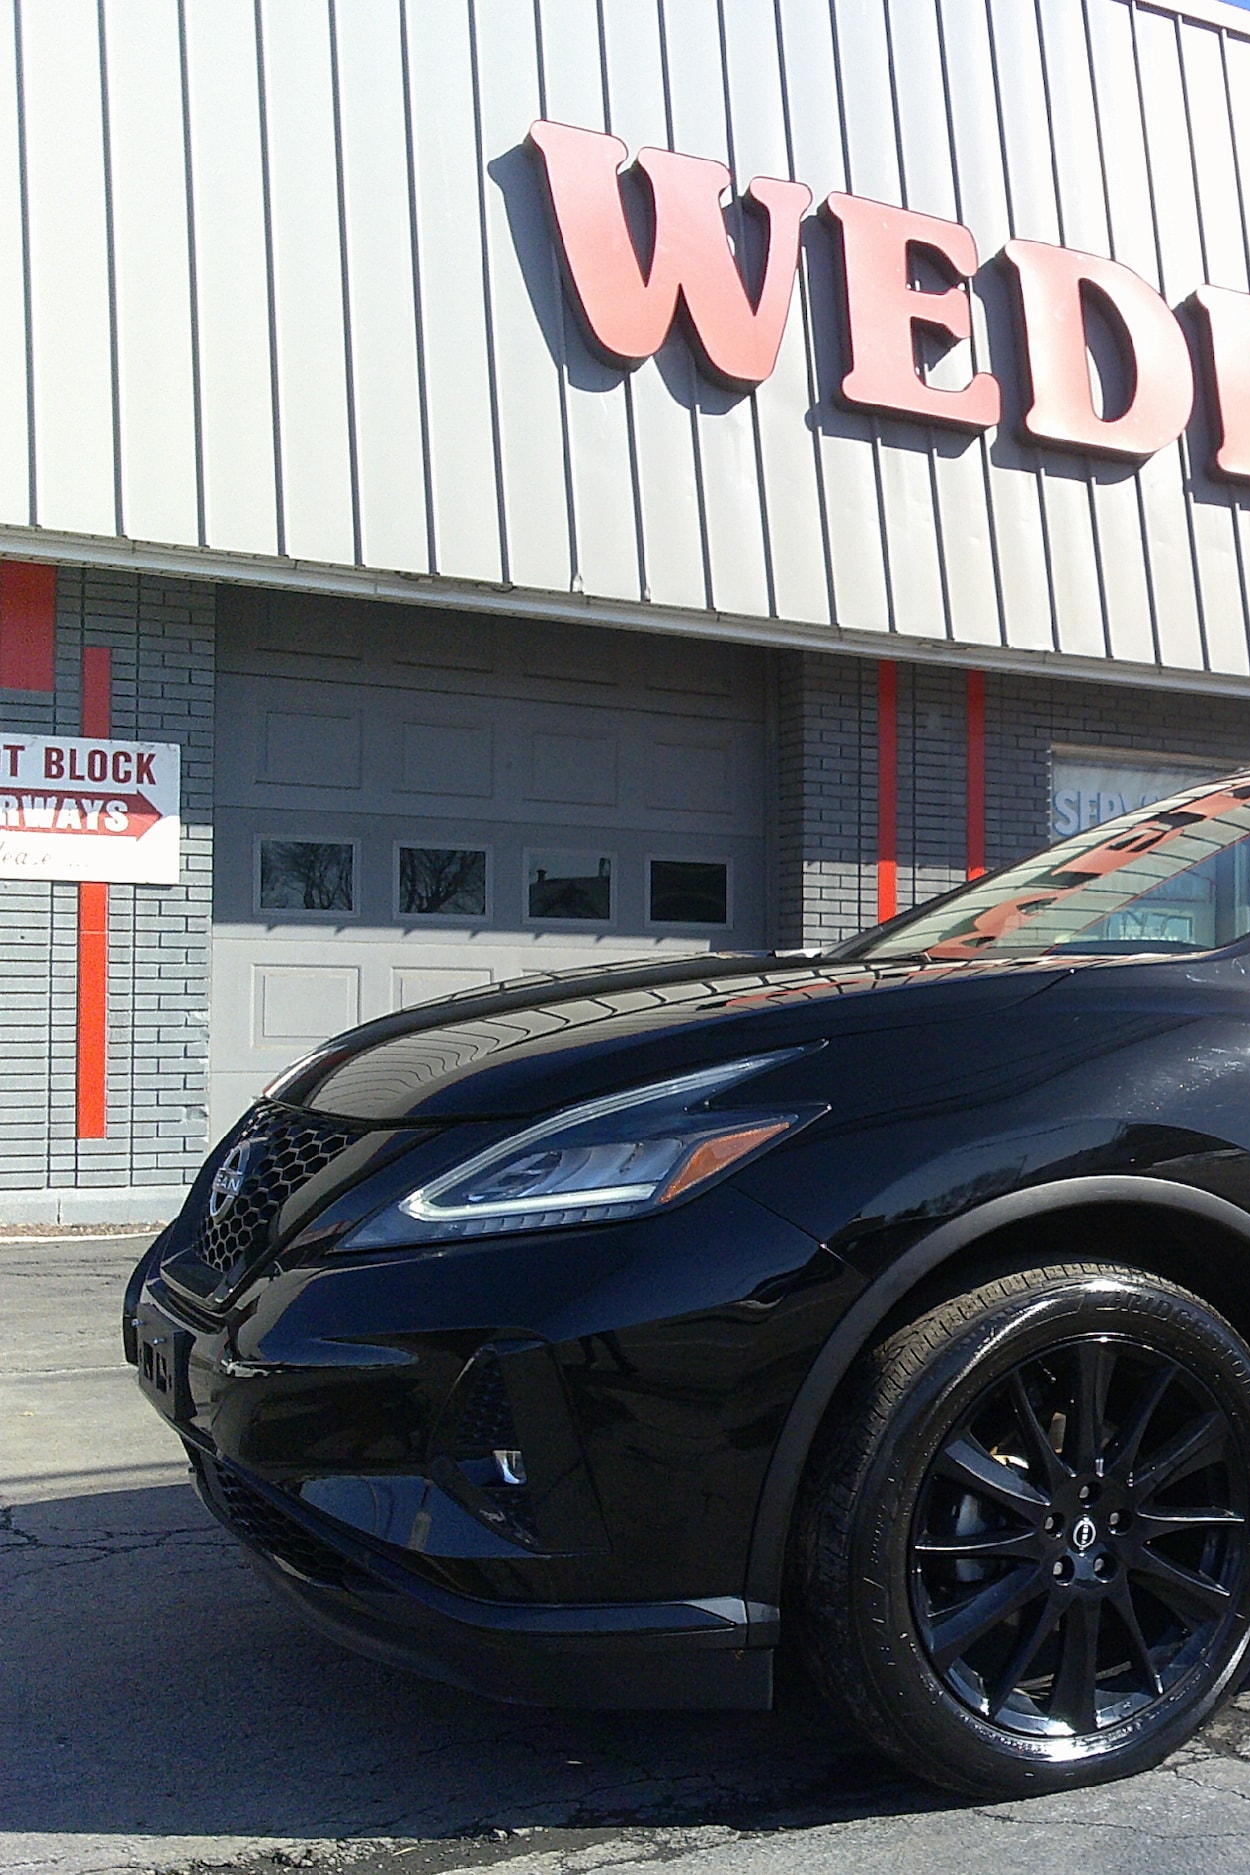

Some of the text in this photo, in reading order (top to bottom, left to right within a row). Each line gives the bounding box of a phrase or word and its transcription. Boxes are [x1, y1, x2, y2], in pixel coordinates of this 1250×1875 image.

[0, 744, 157, 785] T BLOCK
[0, 794, 129, 832] RWAYS
